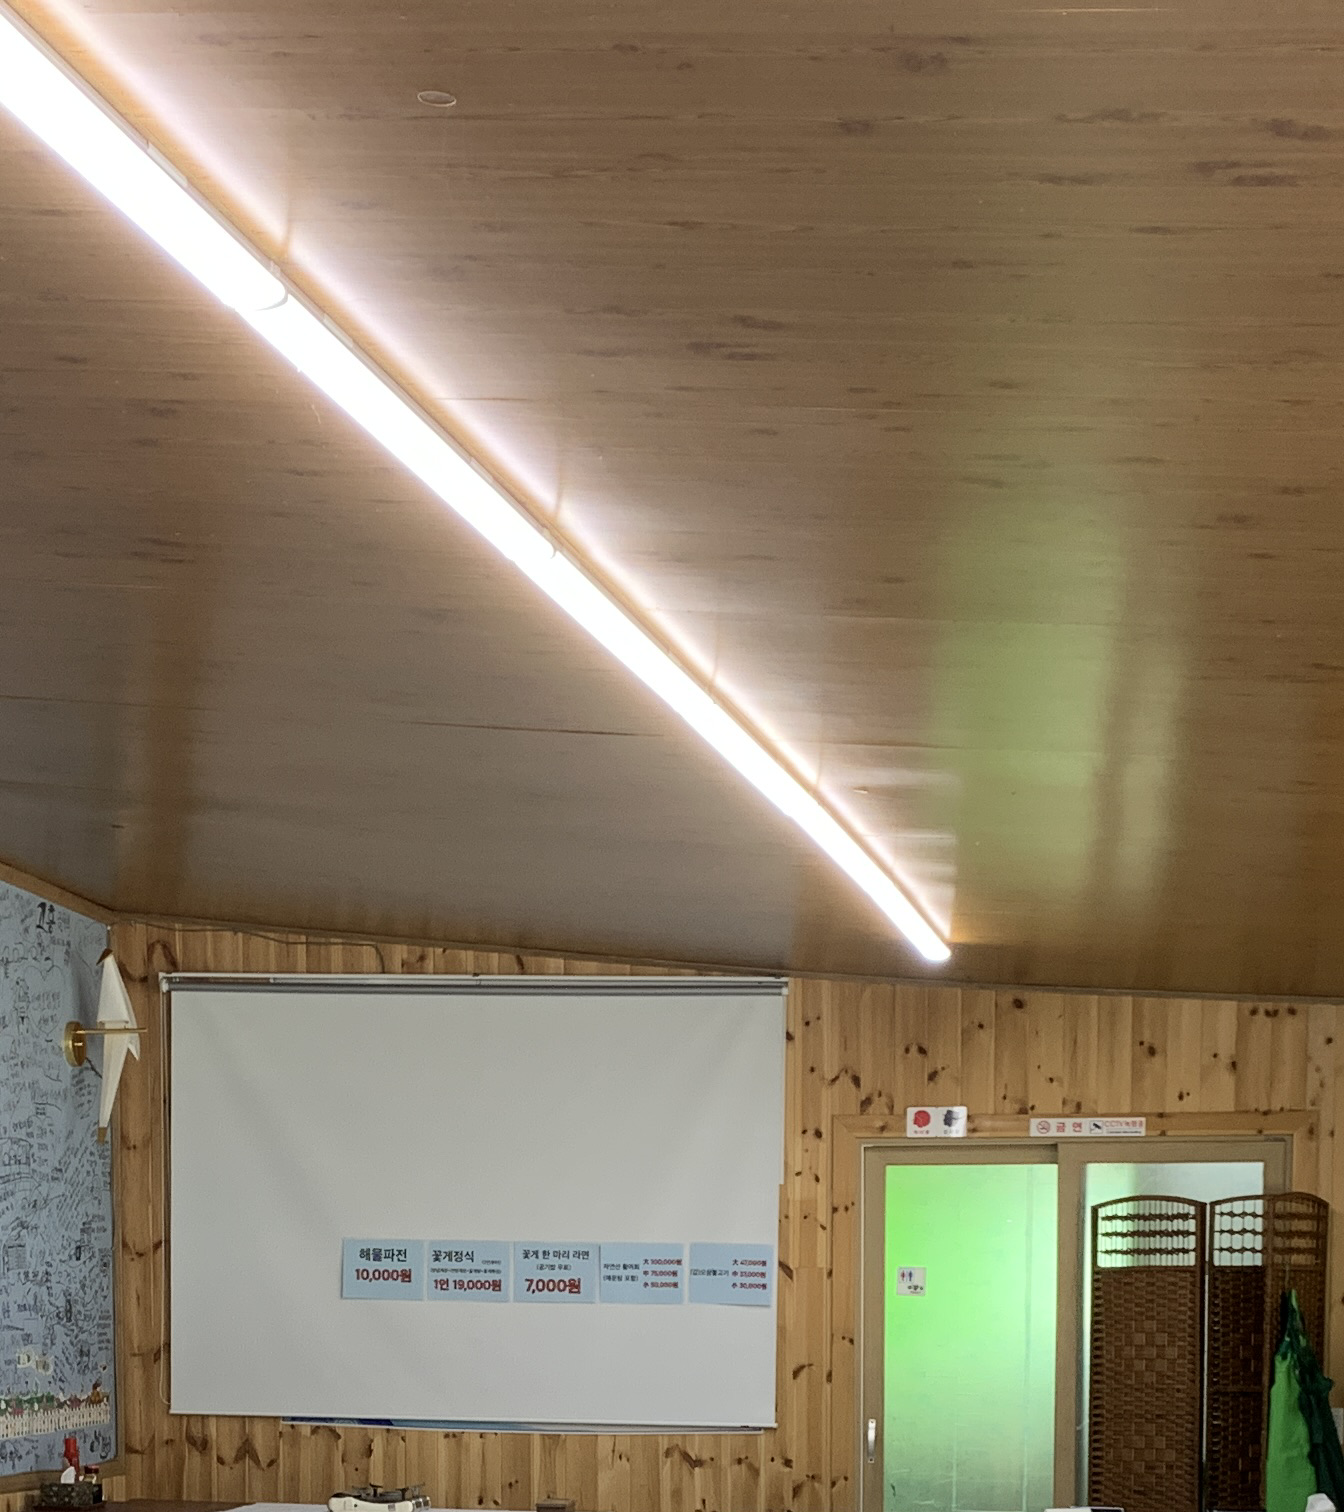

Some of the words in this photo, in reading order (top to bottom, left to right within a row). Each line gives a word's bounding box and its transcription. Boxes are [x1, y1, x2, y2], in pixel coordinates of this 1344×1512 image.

[359, 1247, 407, 1263] 해물파전
[431, 1250, 475, 1263] 꽃게정식
[522, 1249, 540, 1260] 꽃게
[542, 1249, 551, 1260] 한
[552, 1249, 570, 1260] 마리
[572, 1250, 590, 1260] 라면
[354, 1268, 413, 1283] 10,000원
[433, 1278, 450, 1291] 1인
[452, 1279, 502, 1292] 19,000원
[524, 1277, 582, 1295] 7,000원
